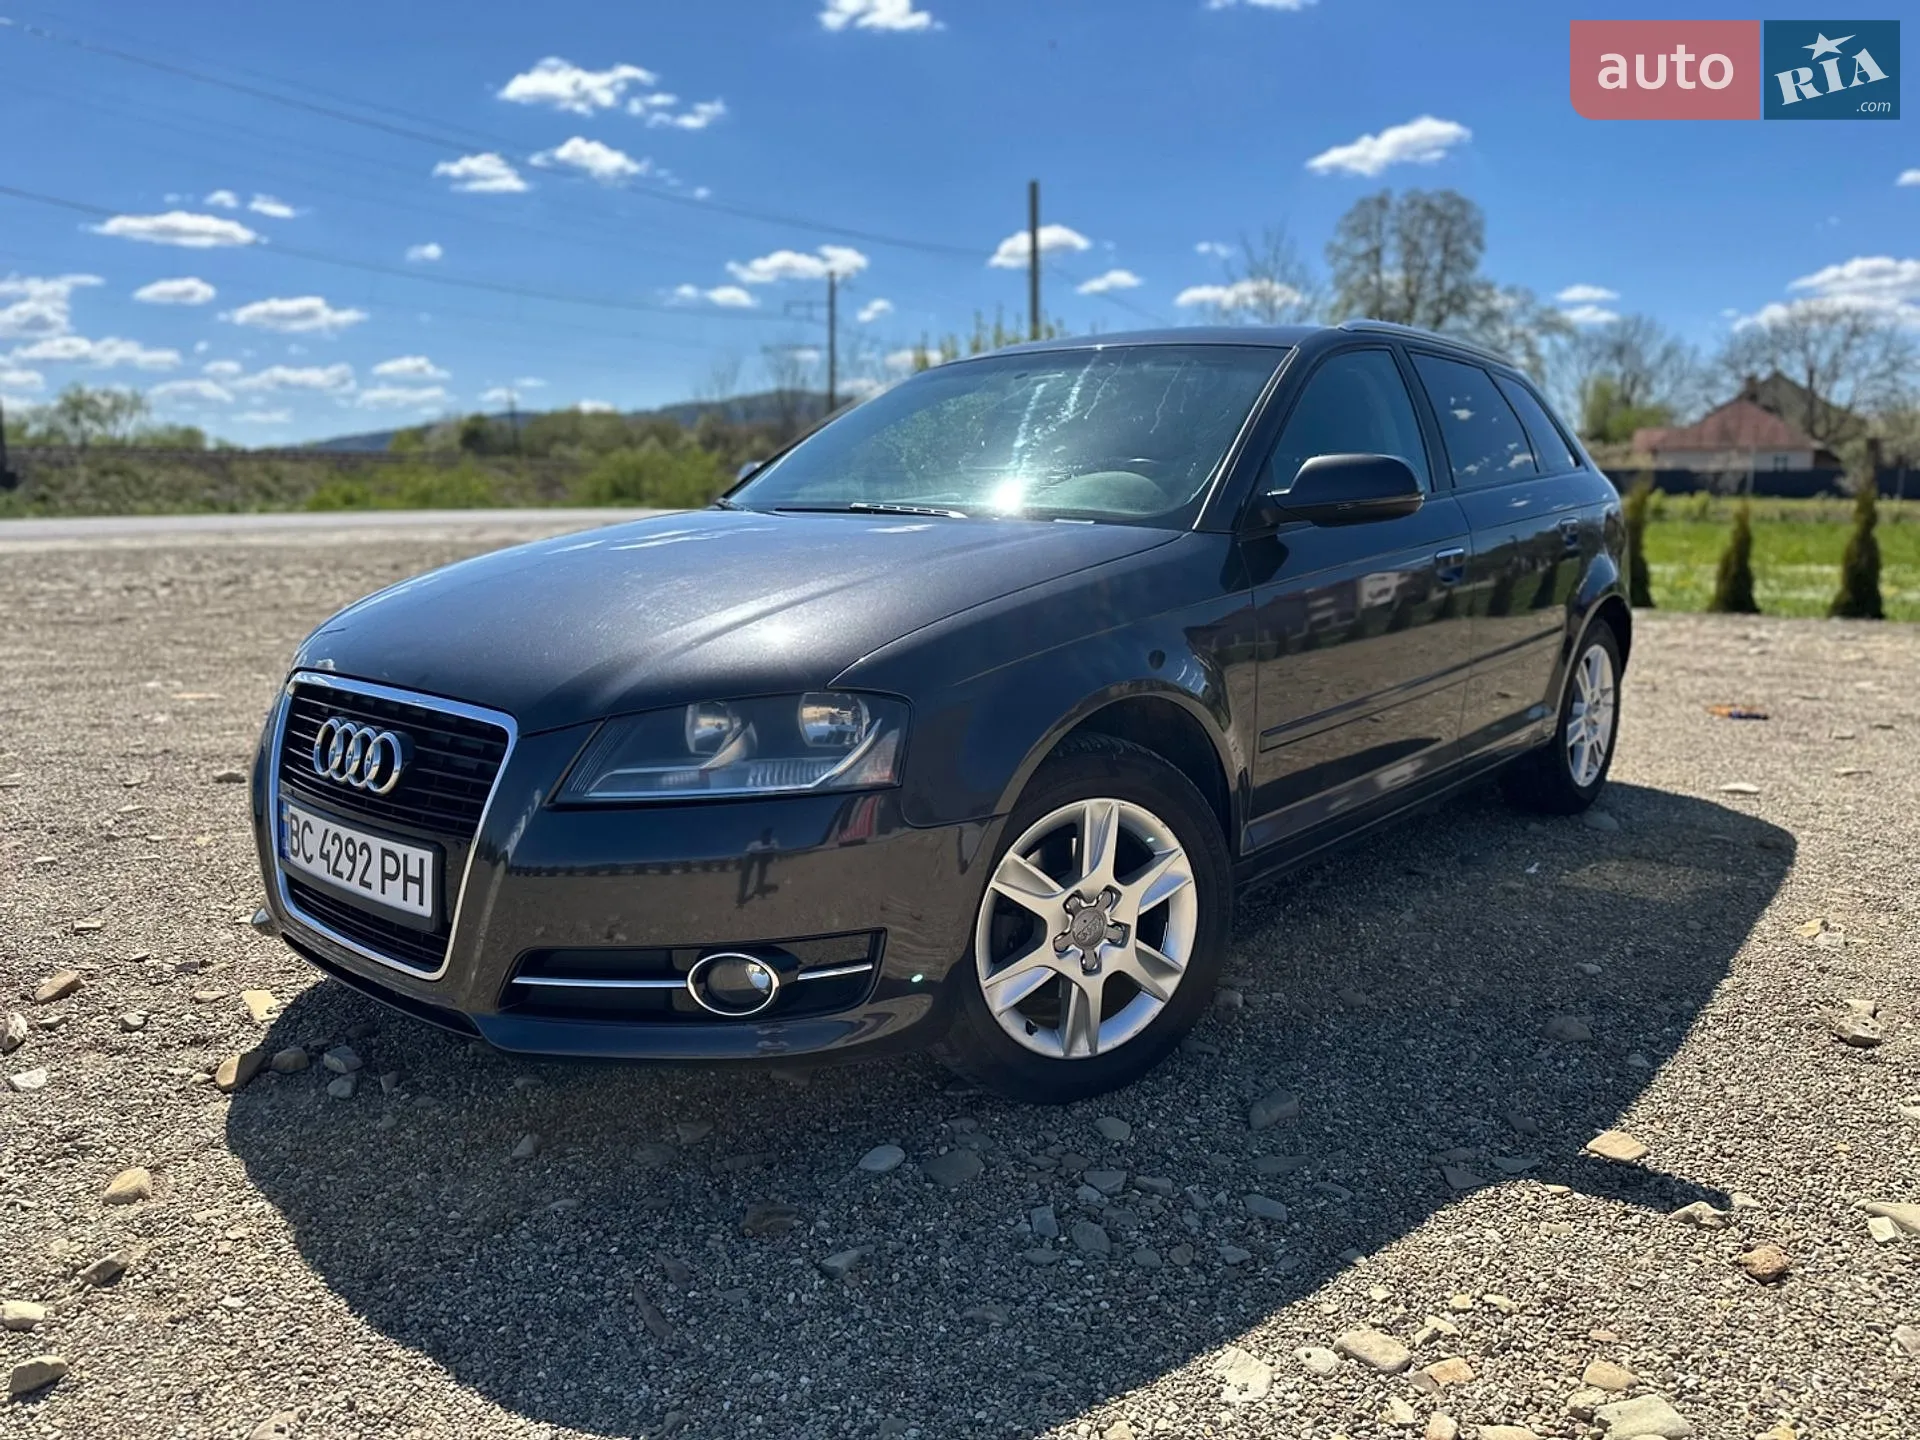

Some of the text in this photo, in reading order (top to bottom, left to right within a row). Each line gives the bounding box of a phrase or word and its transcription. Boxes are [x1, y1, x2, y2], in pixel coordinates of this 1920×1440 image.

[289, 812, 425, 907] BC 4292 PH
